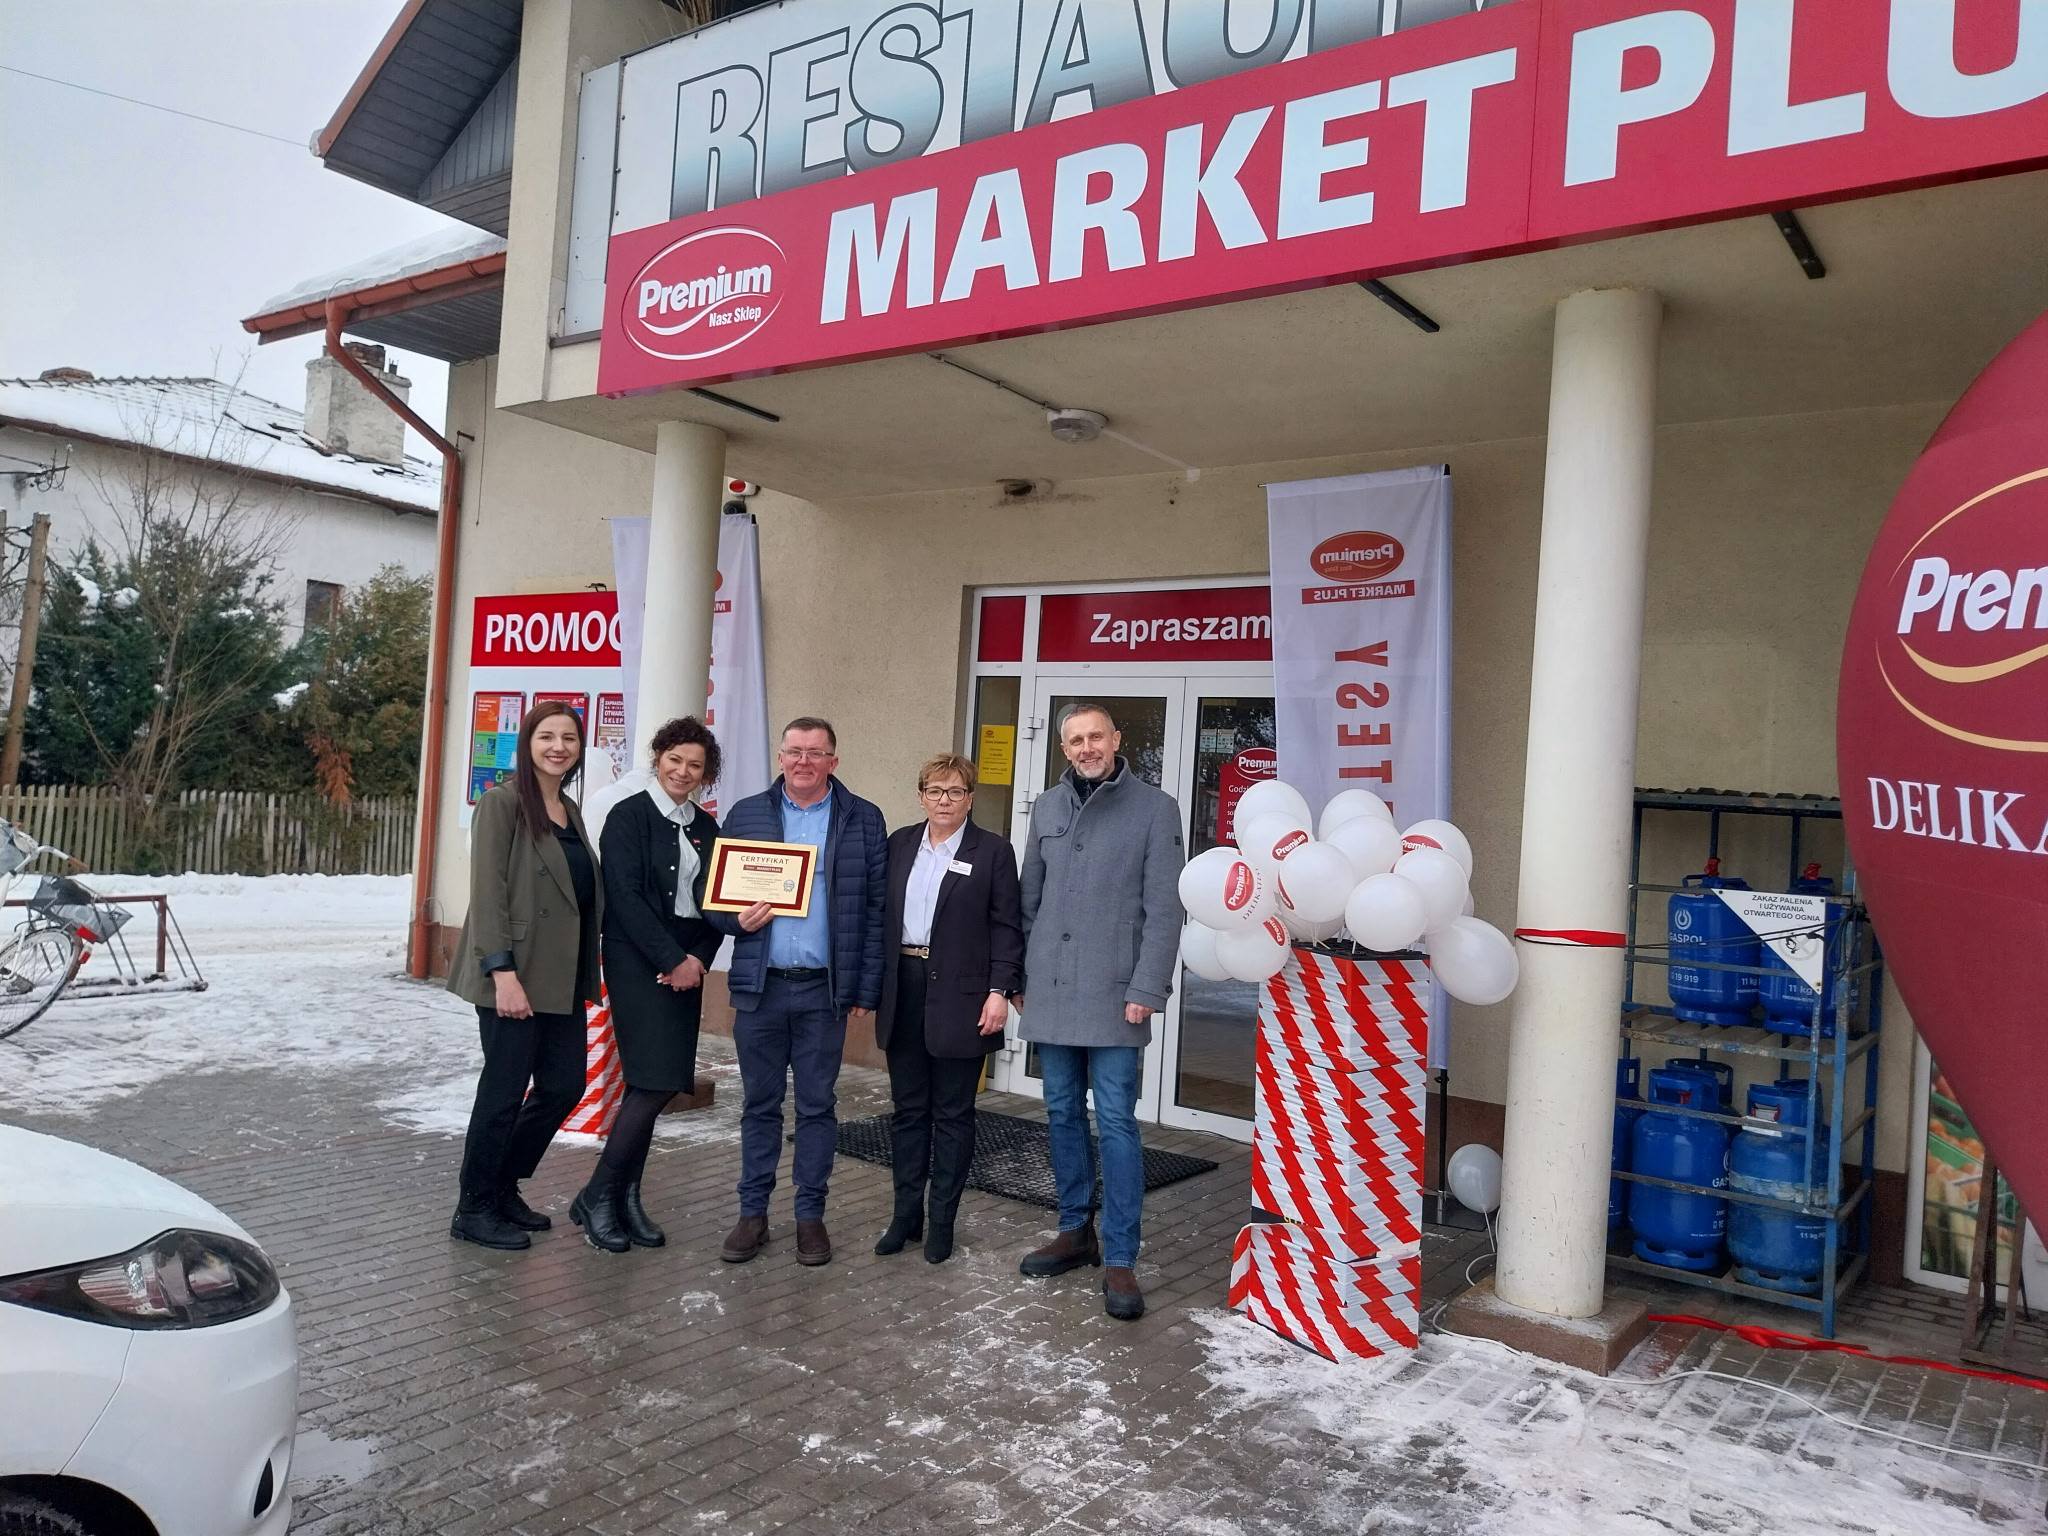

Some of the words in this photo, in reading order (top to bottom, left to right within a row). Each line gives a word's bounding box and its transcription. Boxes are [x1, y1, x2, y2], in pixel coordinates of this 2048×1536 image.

[820, 47, 1516, 324] MARKET
[638, 264, 772, 318] Premium
[708, 312, 735, 327] Nasz
[733, 306, 761, 323] Sklep
[1090, 613, 1271, 650] Zapraszam
[1275, 834, 1306, 856] Premium
[740, 855, 790, 865] CERTYFIKAT
[1228, 865, 1246, 906] Premium
[1780, 896, 1813, 905] PALENIA
[1743, 909, 1793, 919] OTWARTEGO
